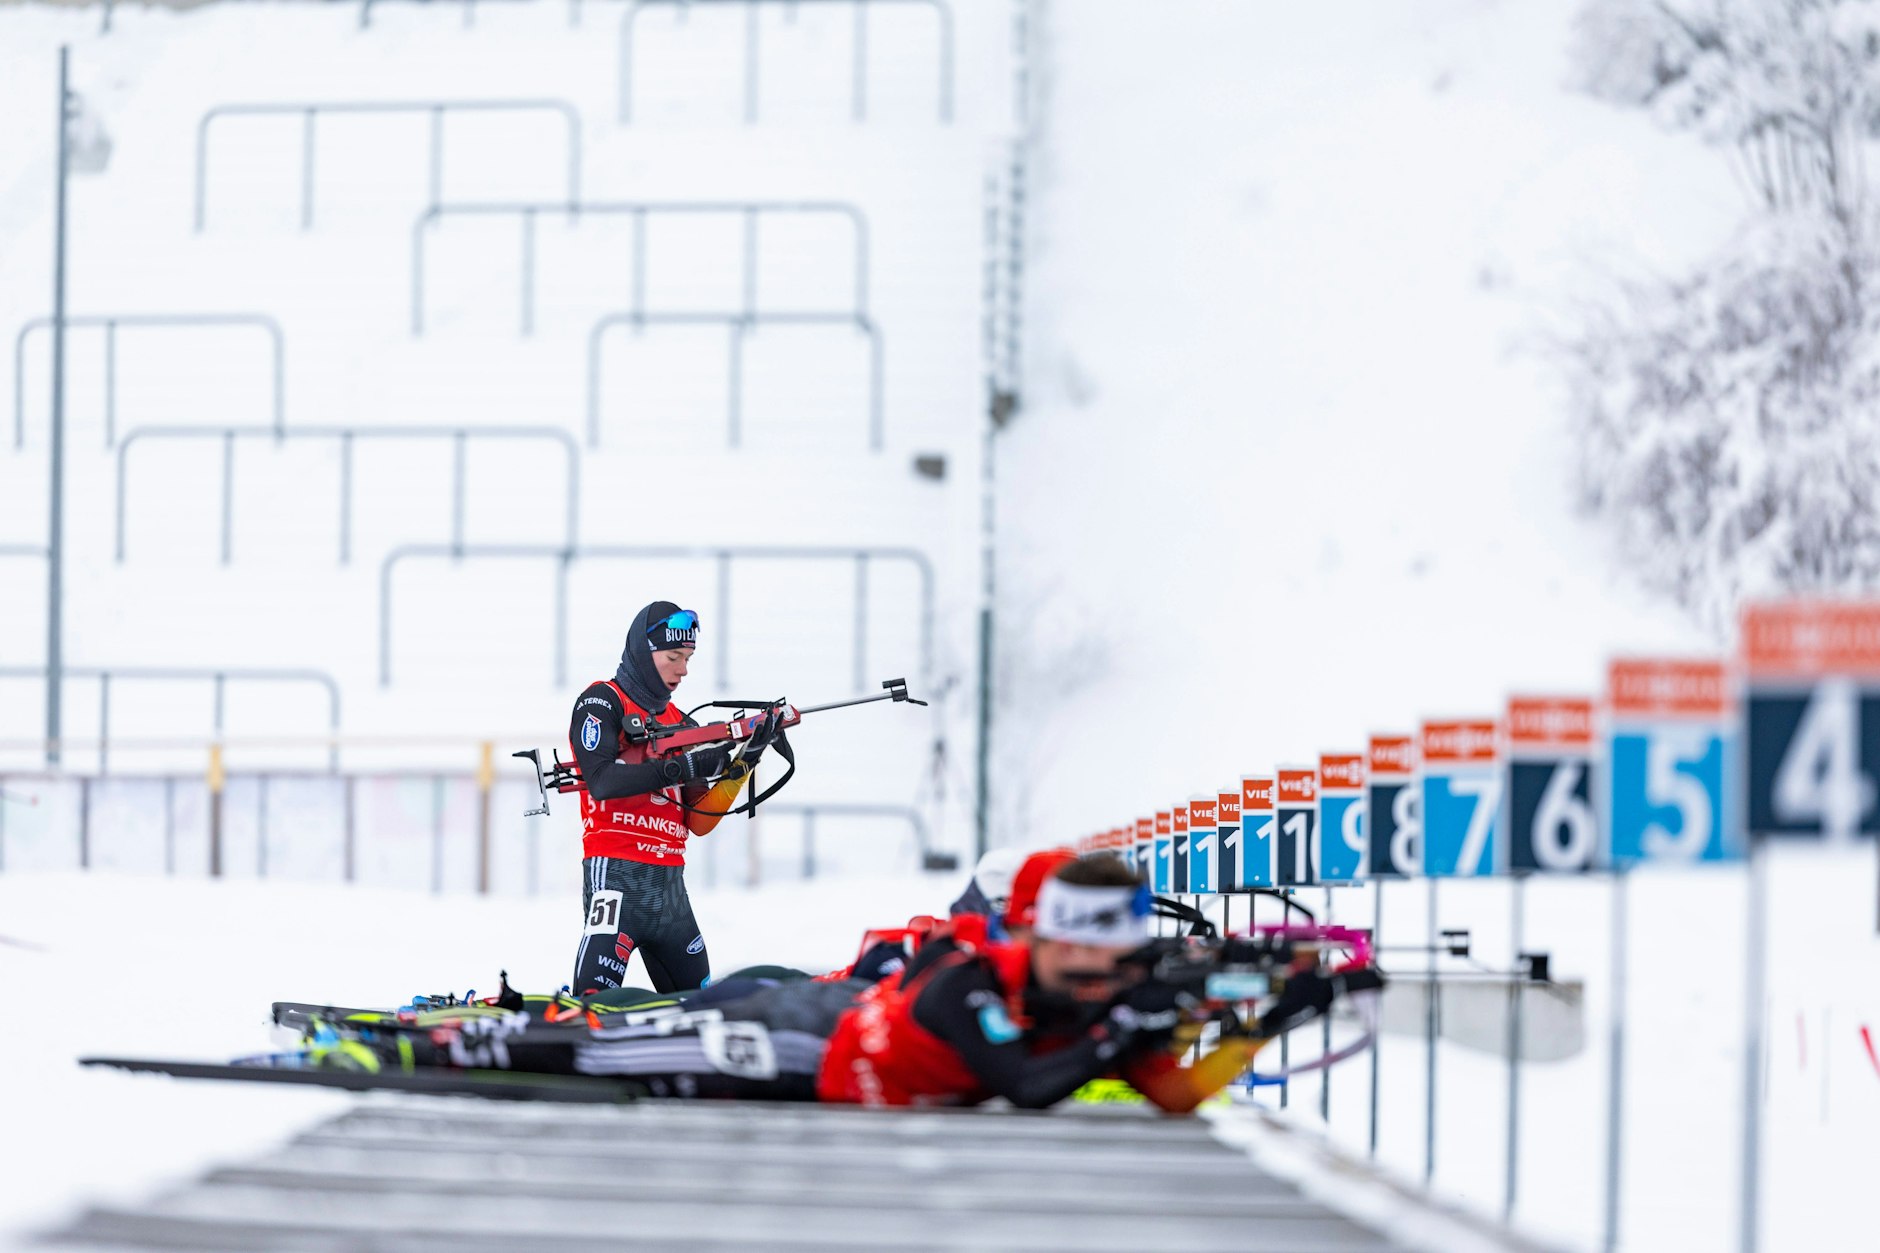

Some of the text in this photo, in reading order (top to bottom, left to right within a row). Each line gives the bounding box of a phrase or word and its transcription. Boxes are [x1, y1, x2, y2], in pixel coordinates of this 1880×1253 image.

[584, 697, 612, 710] TERREX
[1640, 734, 1712, 862] 5
[1772, 678, 1877, 838] 4
[1282, 811, 1318, 883] 1
[1342, 798, 1369, 878] 9
[1389, 786, 1421, 874] 8
[1446, 776, 1500, 877] 7
[1530, 760, 1596, 872] 6
[590, 898, 618, 926] 51
